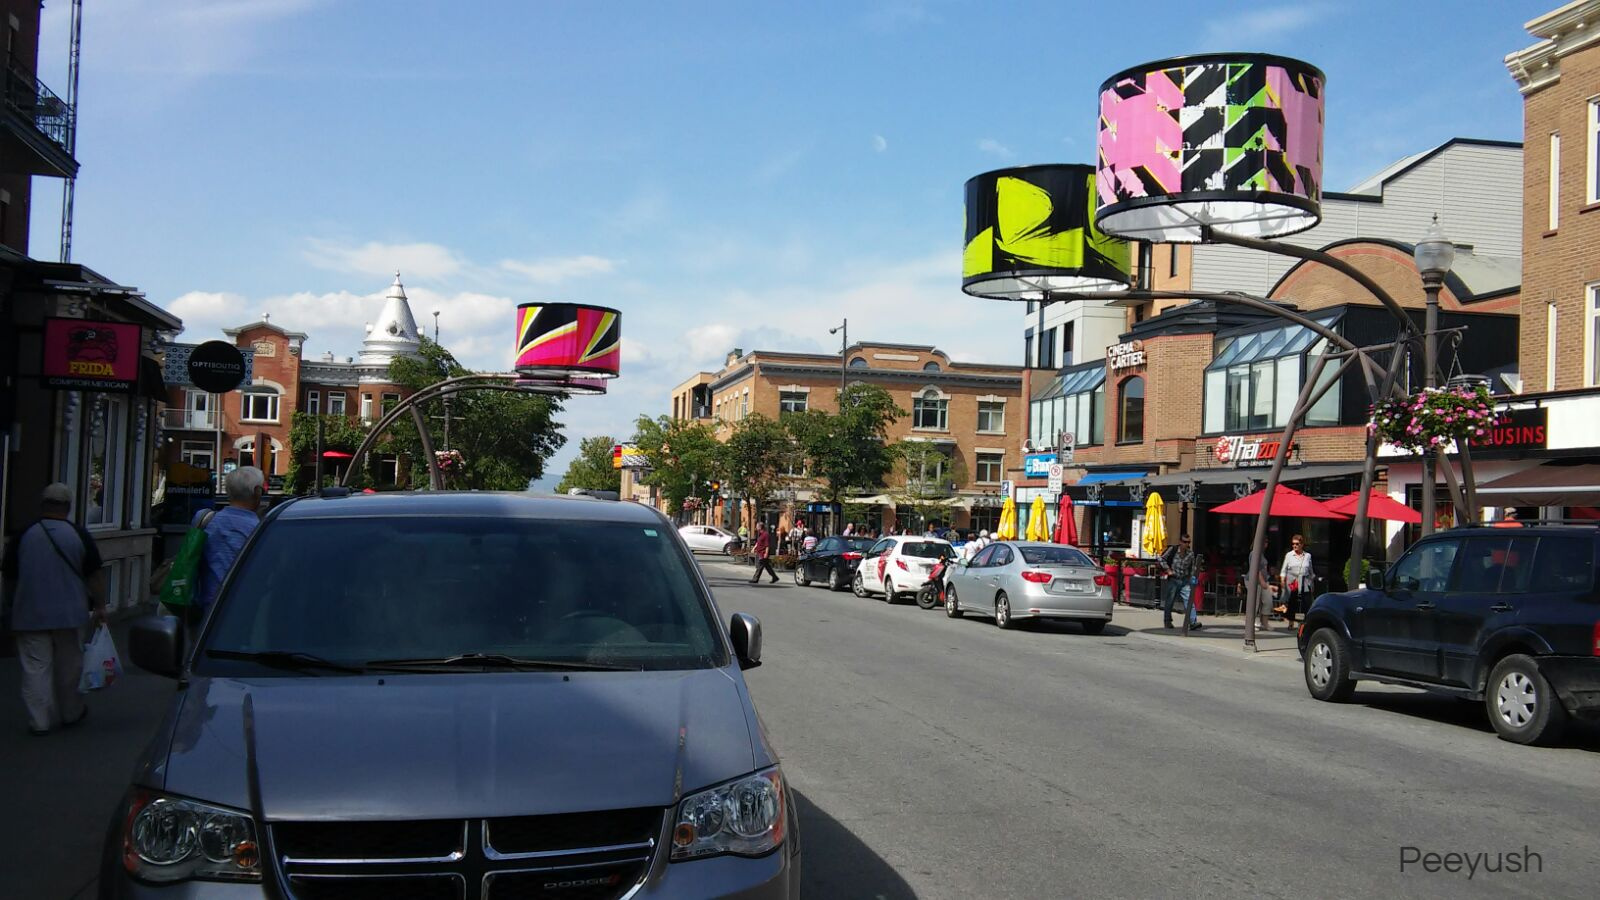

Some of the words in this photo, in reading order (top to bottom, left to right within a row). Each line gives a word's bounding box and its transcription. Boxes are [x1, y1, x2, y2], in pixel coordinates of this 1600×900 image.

[1108, 341, 1134, 357] CINEMA
[1111, 351, 1143, 370] CARTIER
[68, 361, 115, 376] FRIDA
[90, 380, 129, 389] MEXICAIN
[167, 486, 210, 495] animalerie
[543, 876, 609, 889] DODGE
